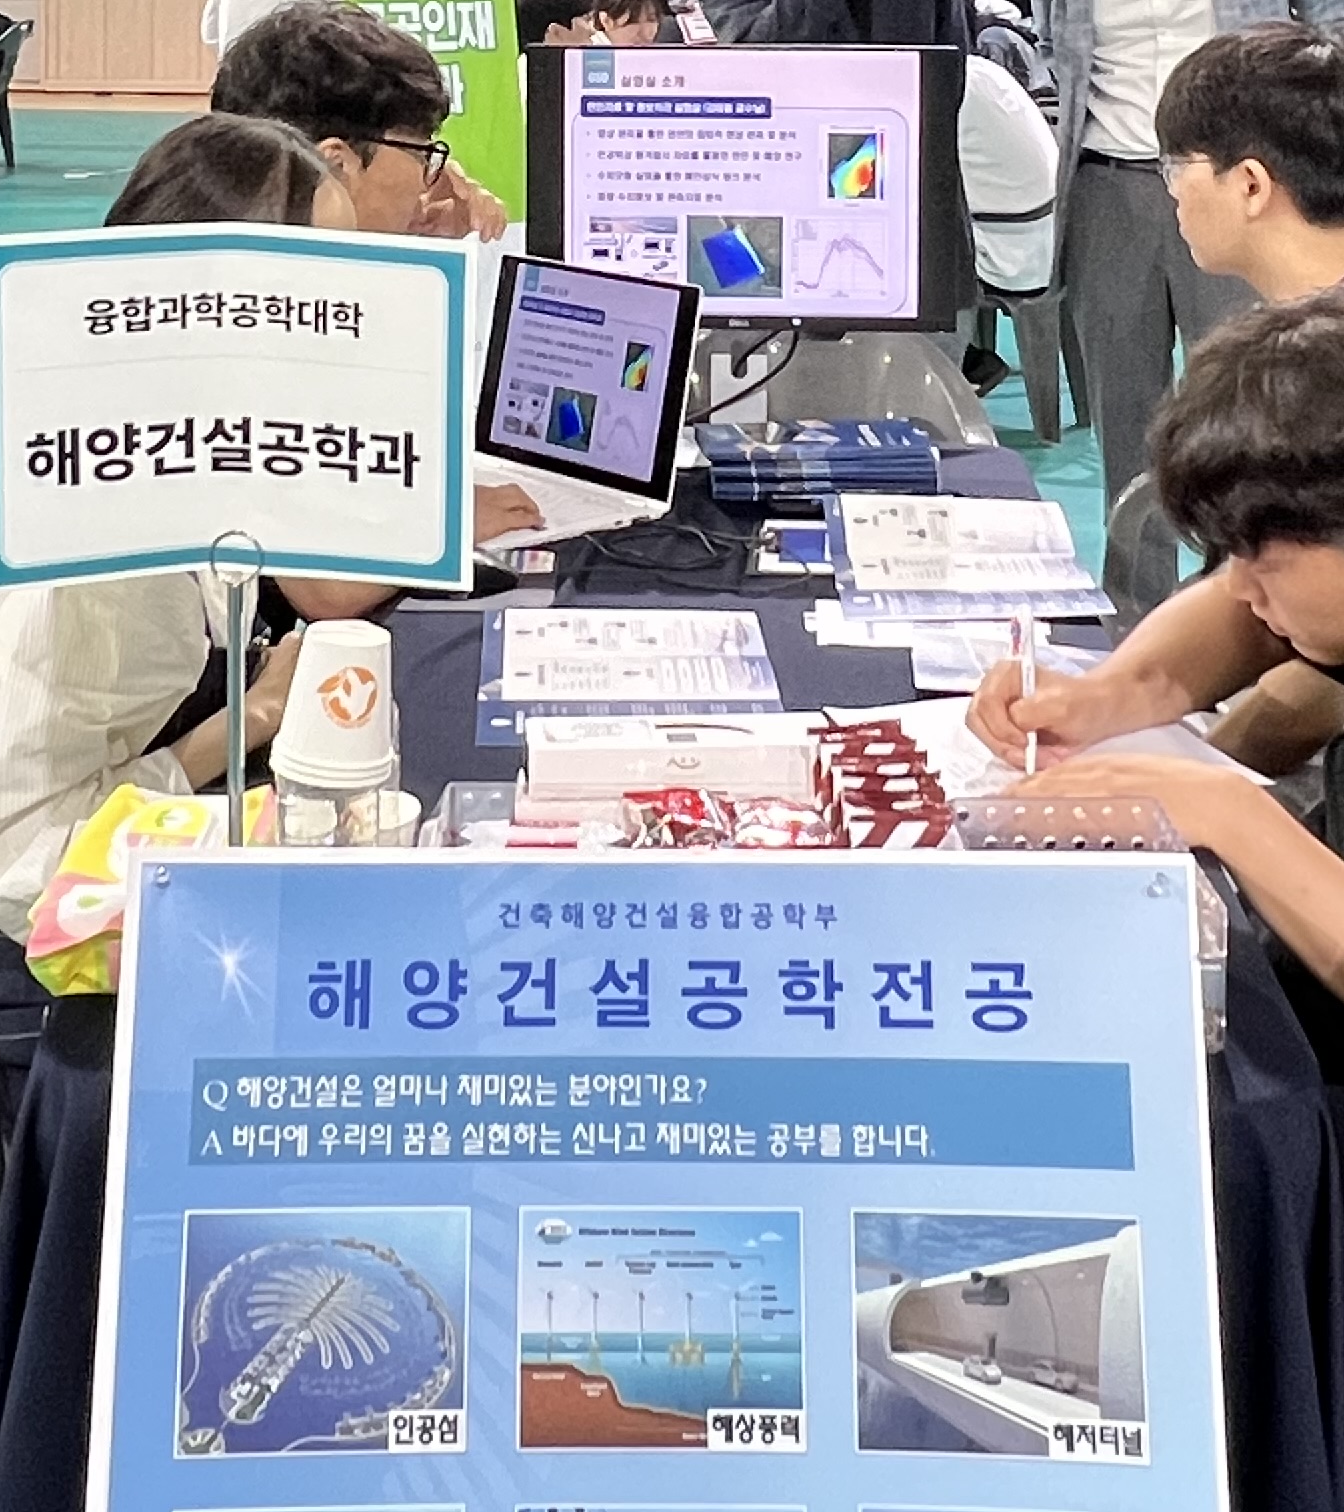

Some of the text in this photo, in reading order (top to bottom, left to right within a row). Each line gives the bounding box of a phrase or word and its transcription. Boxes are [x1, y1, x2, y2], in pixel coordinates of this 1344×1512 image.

[357, 0, 497, 52] 인재
[83, 292, 365, 339] 융합과학공학대학
[26, 415, 421, 488] 해양건설공학과
[498, 901, 839, 931] 건축해양건설융합공학부
[307, 958, 1035, 1033] 해양건설공학전공
[202, 1073, 708, 1112] Q 해양건설은 얼마나 재미있는 분야인가요?
[200, 1121, 936, 1158] A 바다에 우리의 꿈을 실현하는 신나고 재미있는 공부를 합니다.
[392, 1414, 459, 1445] 인공섬
[711, 1413, 801, 1444] 해상풍력
[1052, 1422, 1144, 1457] 해저터널
